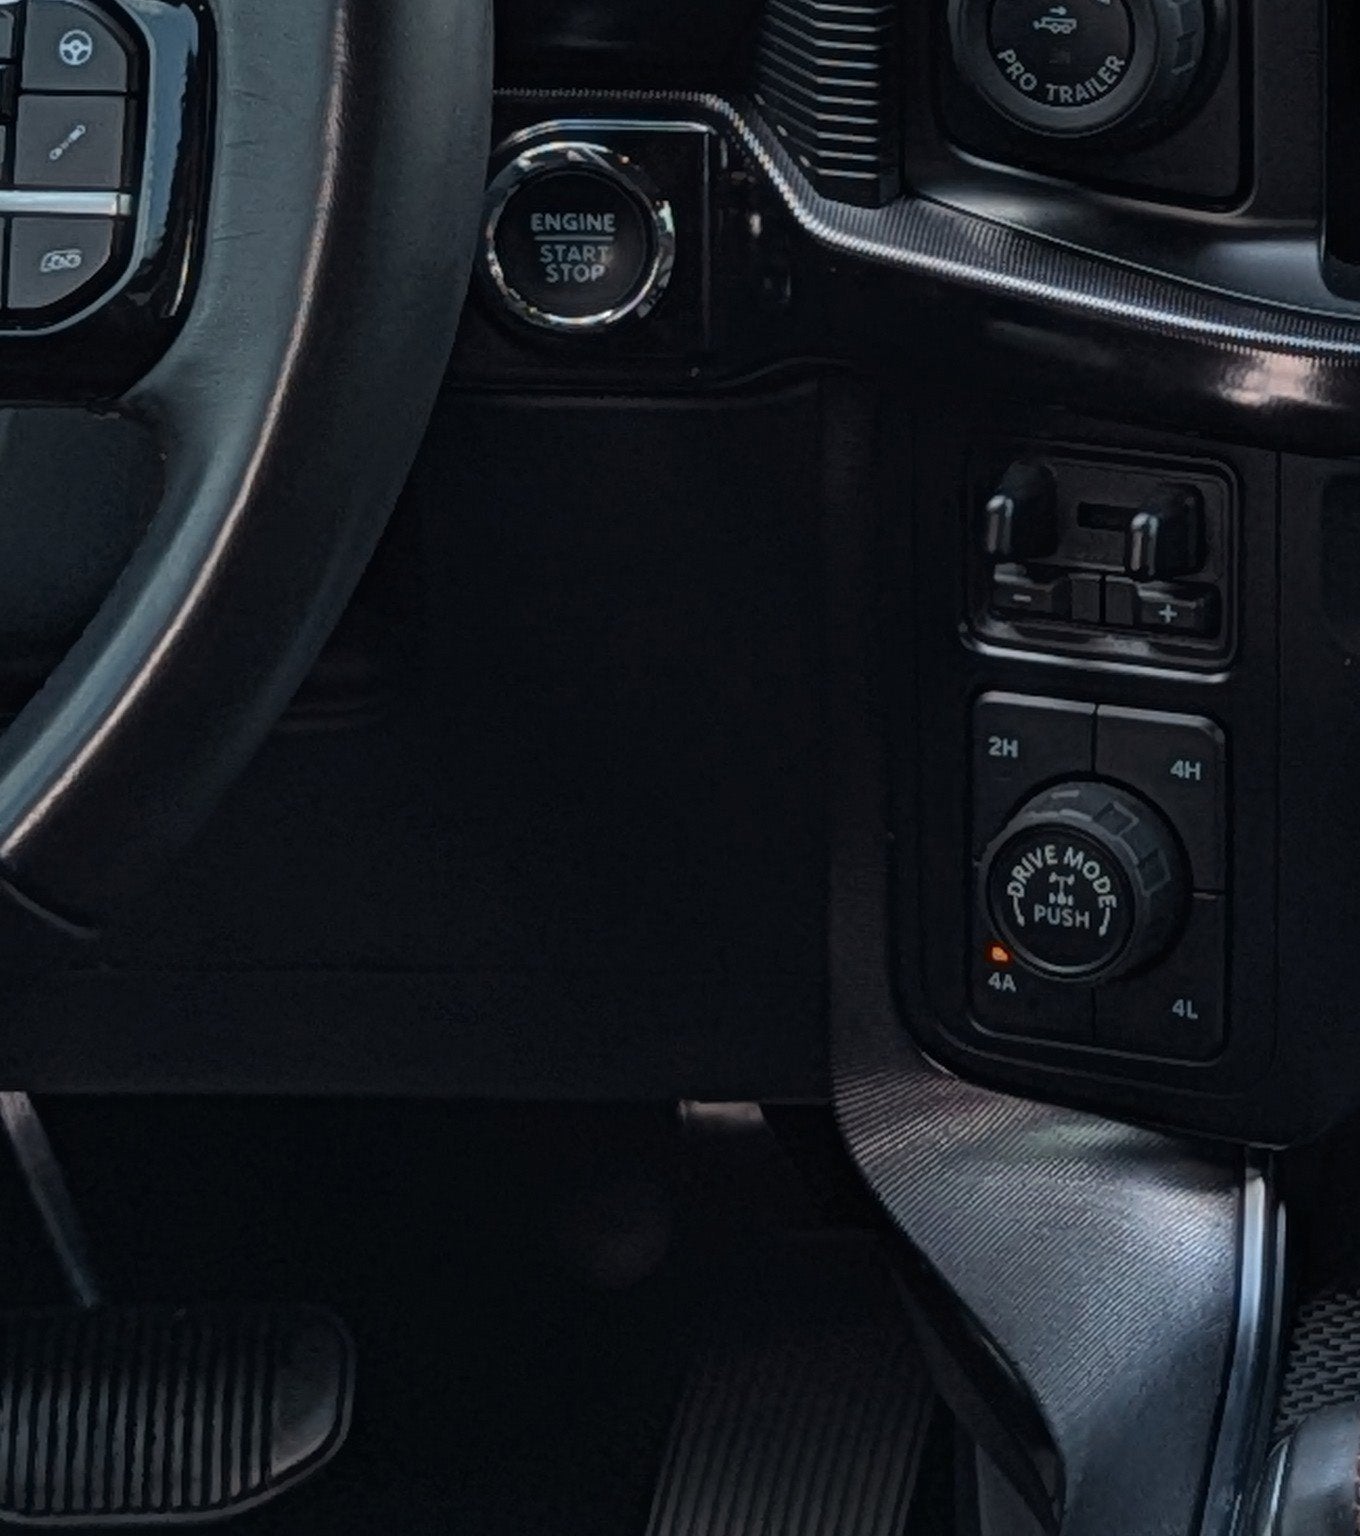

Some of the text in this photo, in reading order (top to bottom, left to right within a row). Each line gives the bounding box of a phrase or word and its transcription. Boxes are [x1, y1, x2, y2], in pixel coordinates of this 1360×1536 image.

[998, 48, 1126, 104] PRO TRAILER
[530, 212, 616, 232] ENGINE
[540, 244, 610, 263] START
[545, 264, 606, 284] STOP
[988, 736, 1019, 759] 2H
[1170, 759, 1201, 781] 4H
[1006, 844, 1118, 908] DRIVE MODE
[1033, 903, 1090, 930] PUSH
[988, 971, 1017, 992] 4A
[1172, 998, 1199, 1020] 4L
